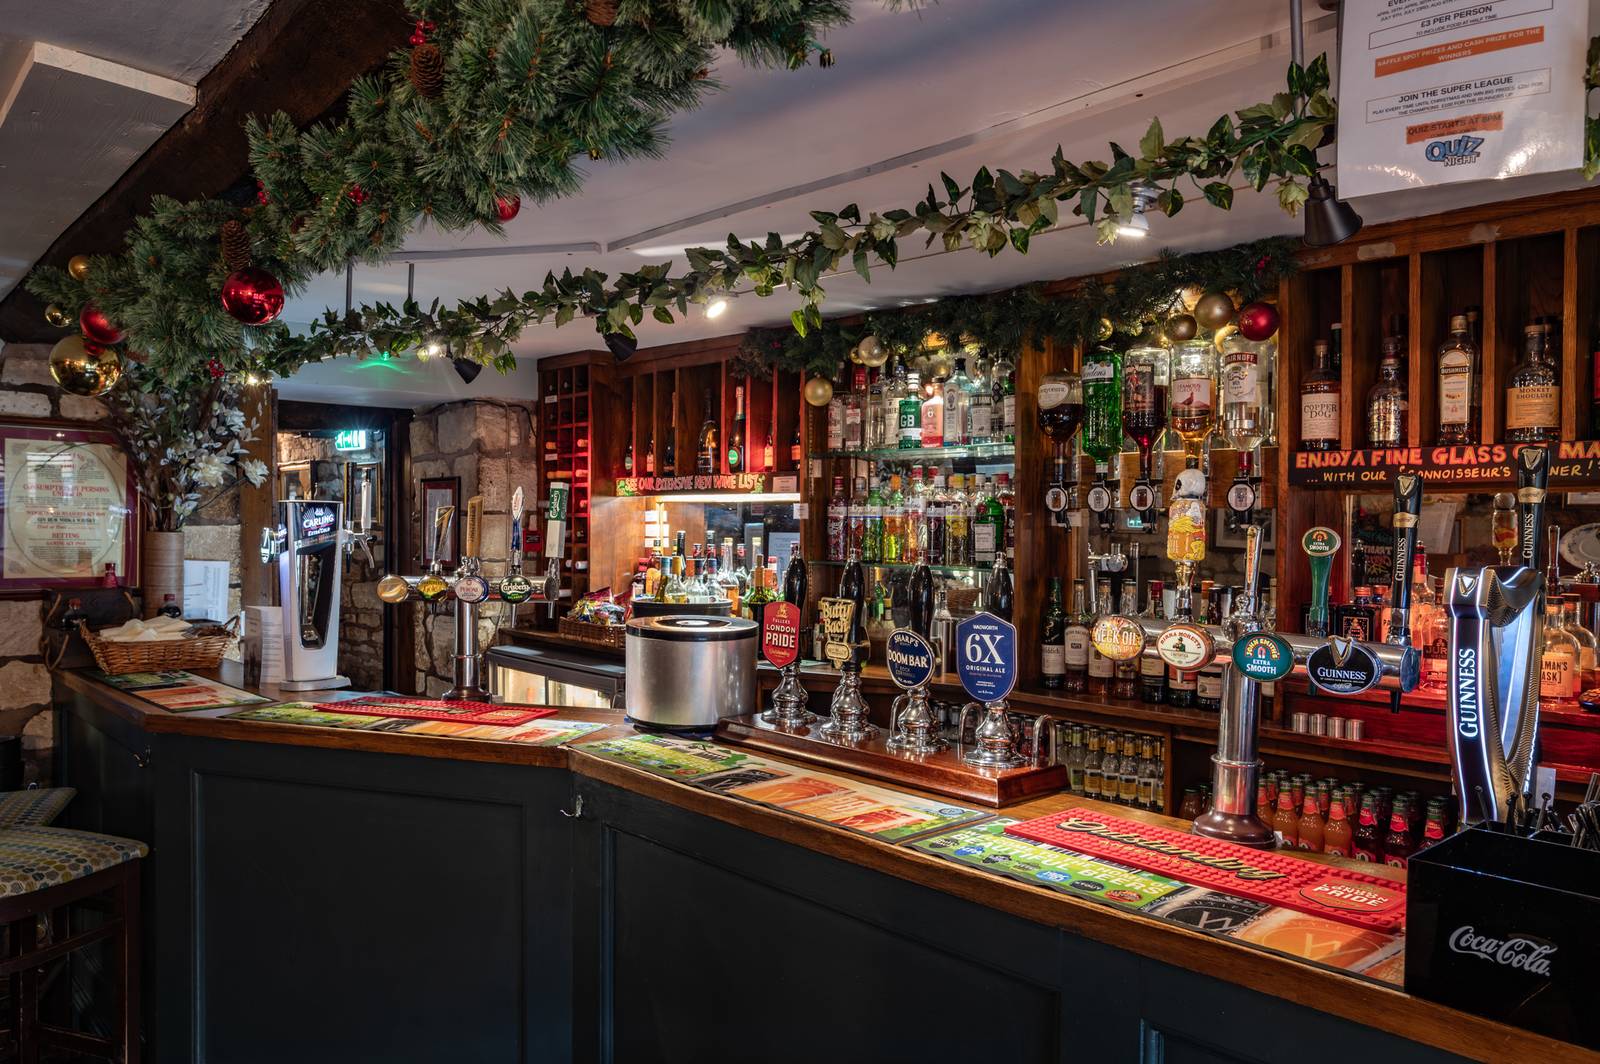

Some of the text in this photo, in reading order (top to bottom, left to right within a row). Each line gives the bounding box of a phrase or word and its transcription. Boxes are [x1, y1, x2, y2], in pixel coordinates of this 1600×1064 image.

[1420, 5, 1493, 28] £3 PER PERSON
[1377, 57, 1401, 67] RAFFLE
[1421, 47, 1446, 57] PRIZES
[1447, 43, 1463, 52] AND
[1464, 38, 1485, 48] CASH
[1485, 33, 1507, 43] PRIZE
[1508, 31, 1525, 39] FOR
[1526, 28, 1541, 36] THE
[1438, 49, 1473, 61] WINNERS
[1398, 76, 1513, 103] JOIN THE SUPER LEAGUE
[1407, 125, 1430, 136] QUIZ
[1425, 135, 1485, 162] QUIZ
[1444, 154, 1480, 167] NIGHT
[1304, 403, 1337, 414] COPPER
[1310, 410, 1332, 419] DOG
[900, 414, 915, 428] GB
[1296, 450, 1351, 468] ENJOY
[1351, 450, 1366, 466] A
[1370, 447, 1423, 467] FINE
[1431, 444, 1507, 466] GLASS
[625, 478, 638, 491] SEE
[638, 477, 656, 491] OUR
[694, 475, 713, 490] NEW
[713, 475, 737, 490] WINE
[738, 473, 759, 490] LIST
[1322, 471, 1356, 482] WITH
[1360, 470, 1387, 481] OUR
[303, 514, 335, 528] CARLING
[1522, 512, 1535, 559] GUINNESS
[1394, 537, 1406, 581] GUINNESS
[501, 581, 532, 593] Carlsberg
[766, 623, 796, 633] LONDON
[824, 617, 849, 634] Bach
[765, 632, 796, 648] PRIDE
[894, 634, 919, 648] SHARP'S
[1122, 631, 1137, 646] OIL
[965, 633, 1005, 665] 6X
[1245, 638, 1259, 657] JOHN
[1425, 646, 1447, 656] JUR
[888, 649, 929, 669] DOOM BAR
[1252, 659, 1270, 667] EXTRA
[966, 665, 993, 673] ORIGINAL
[1246, 664, 1277, 675] SMOOTH
[1317, 666, 1367, 680] GUINNESS
[1459, 648, 1478, 738] GUINNESS
[1057, 817, 1287, 881] Outstanding
[1076, 868, 1165, 895] BEERS
[1312, 886, 1380, 907] PRIDE
[1321, 883, 1389, 904] LONDON
[1449, 925, 1558, 976] Coca-Cola
